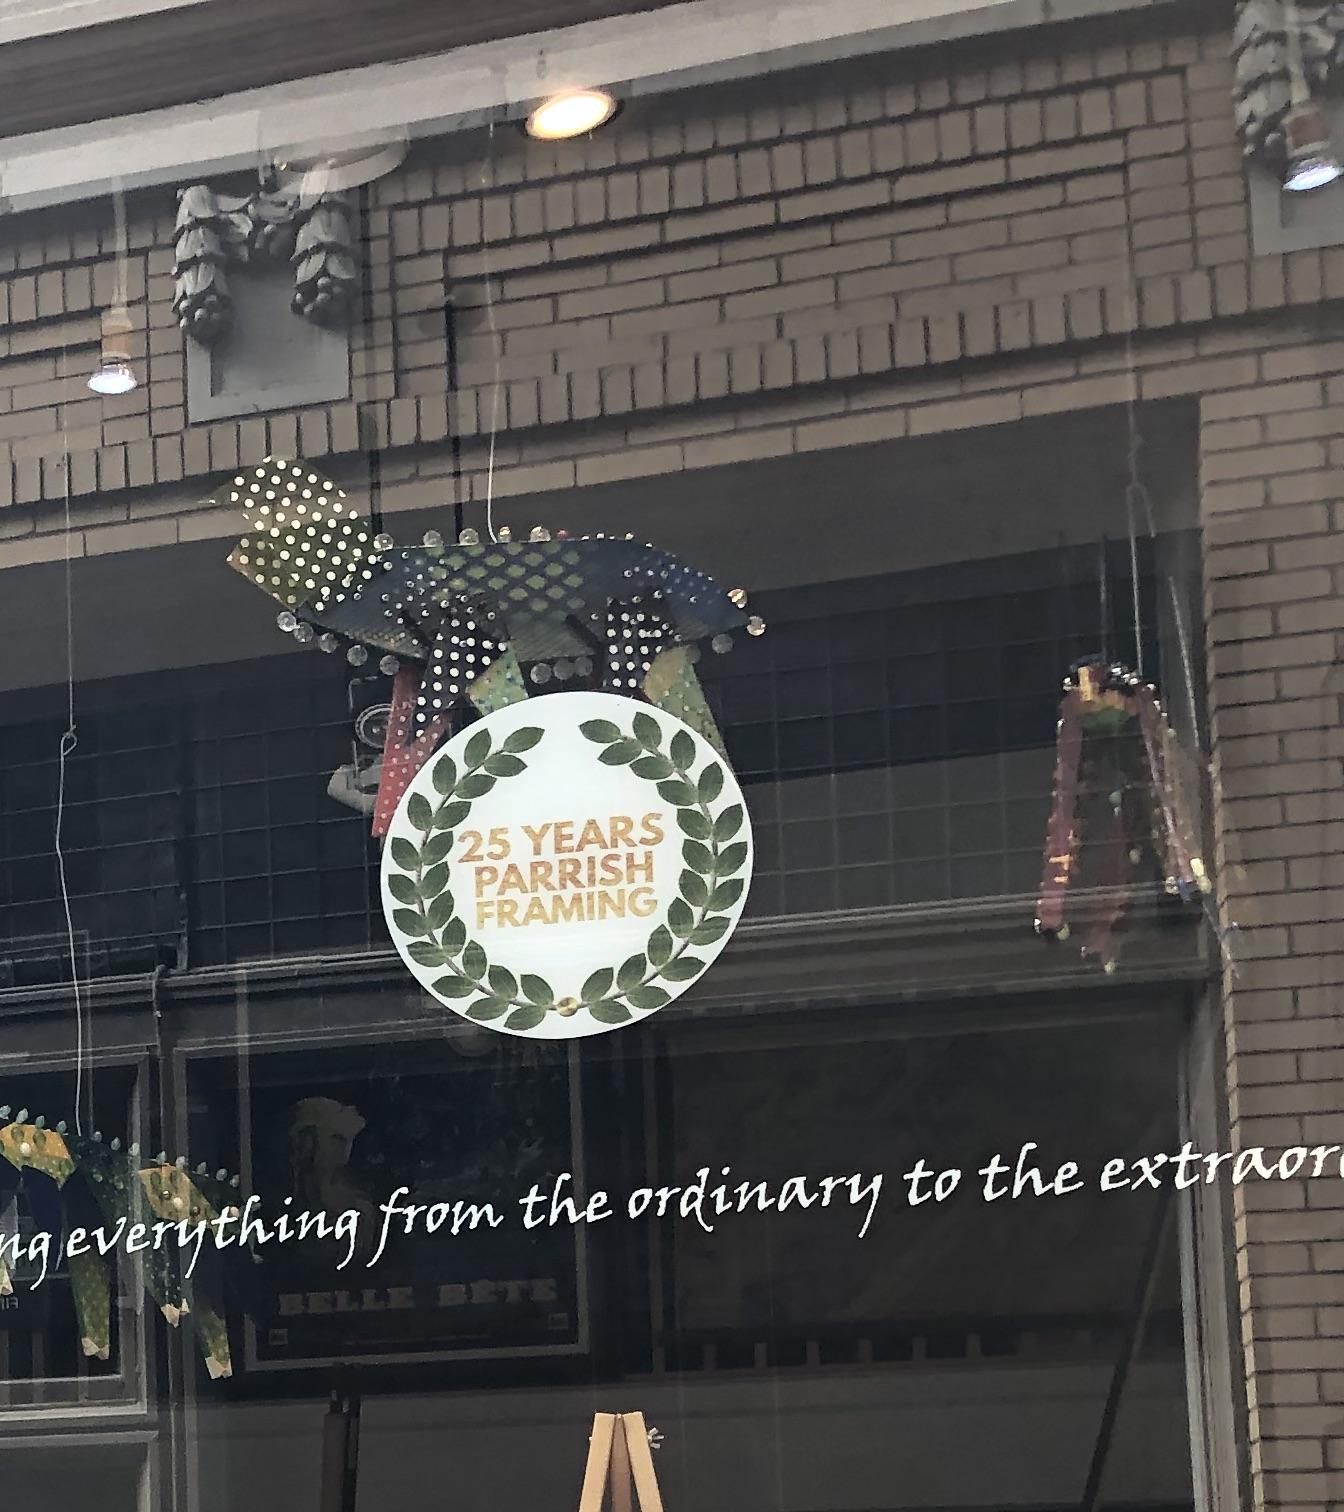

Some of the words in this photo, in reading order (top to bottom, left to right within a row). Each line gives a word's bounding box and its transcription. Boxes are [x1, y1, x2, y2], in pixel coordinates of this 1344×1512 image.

[458, 826, 510, 865] 25
[521, 811, 666, 857] YEARS
[475, 850, 655, 899] PARRISH
[475, 887, 659, 931] FRAMING
[58, 1196, 360, 1280] everything
[367, 1187, 505, 1270] from
[519, 1172, 613, 1231] the
[628, 1166, 884, 1238] ordinary
[903, 1158, 964, 1204] to
[979, 1141, 1084, 1202] the
